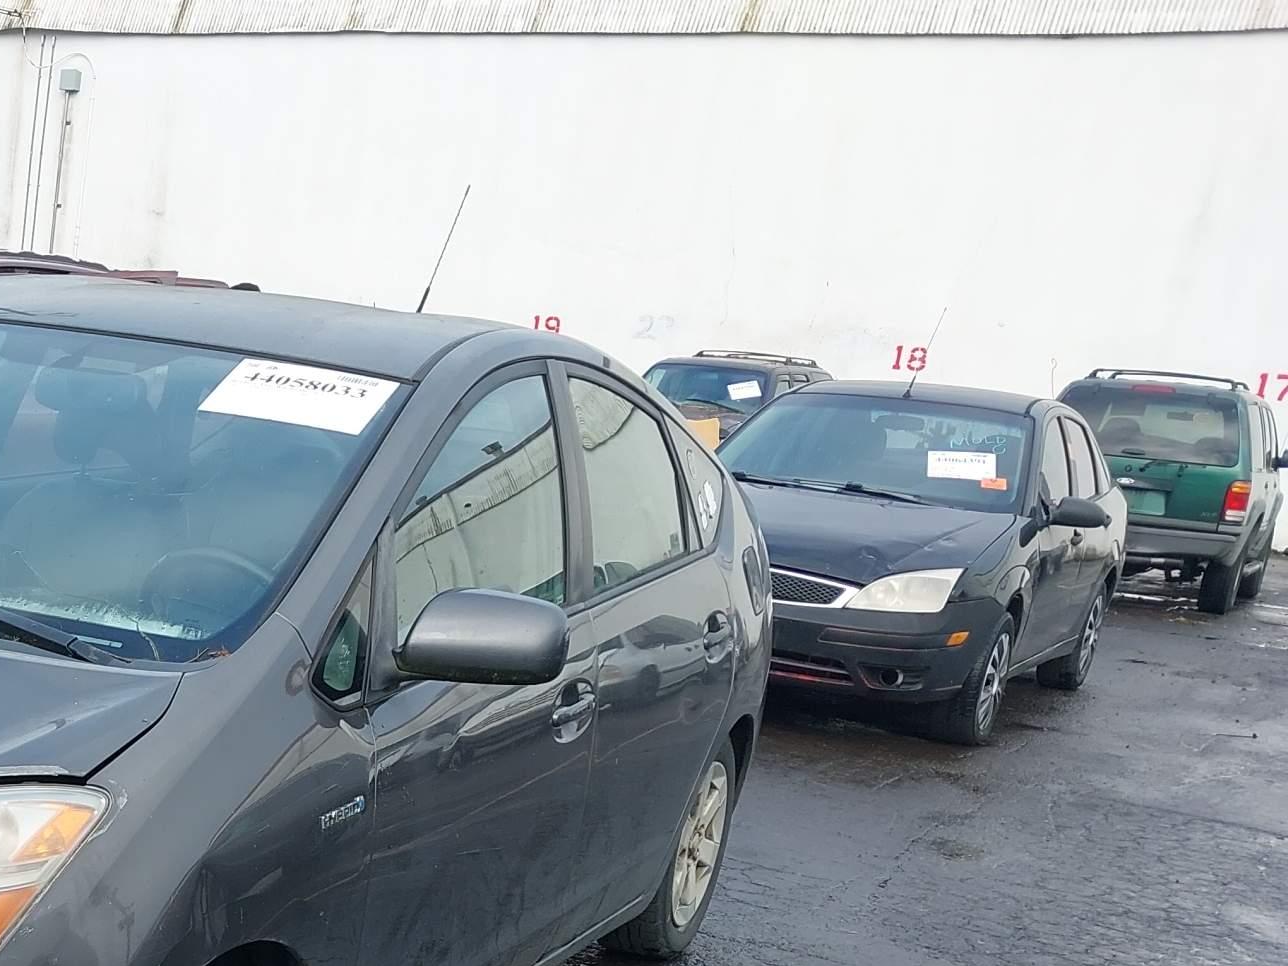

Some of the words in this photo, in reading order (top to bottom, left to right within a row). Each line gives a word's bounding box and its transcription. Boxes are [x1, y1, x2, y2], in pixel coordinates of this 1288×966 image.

[534, 315, 561, 333] 19
[892, 345, 928, 371] 18
[245, 371, 368, 400] 44058033
